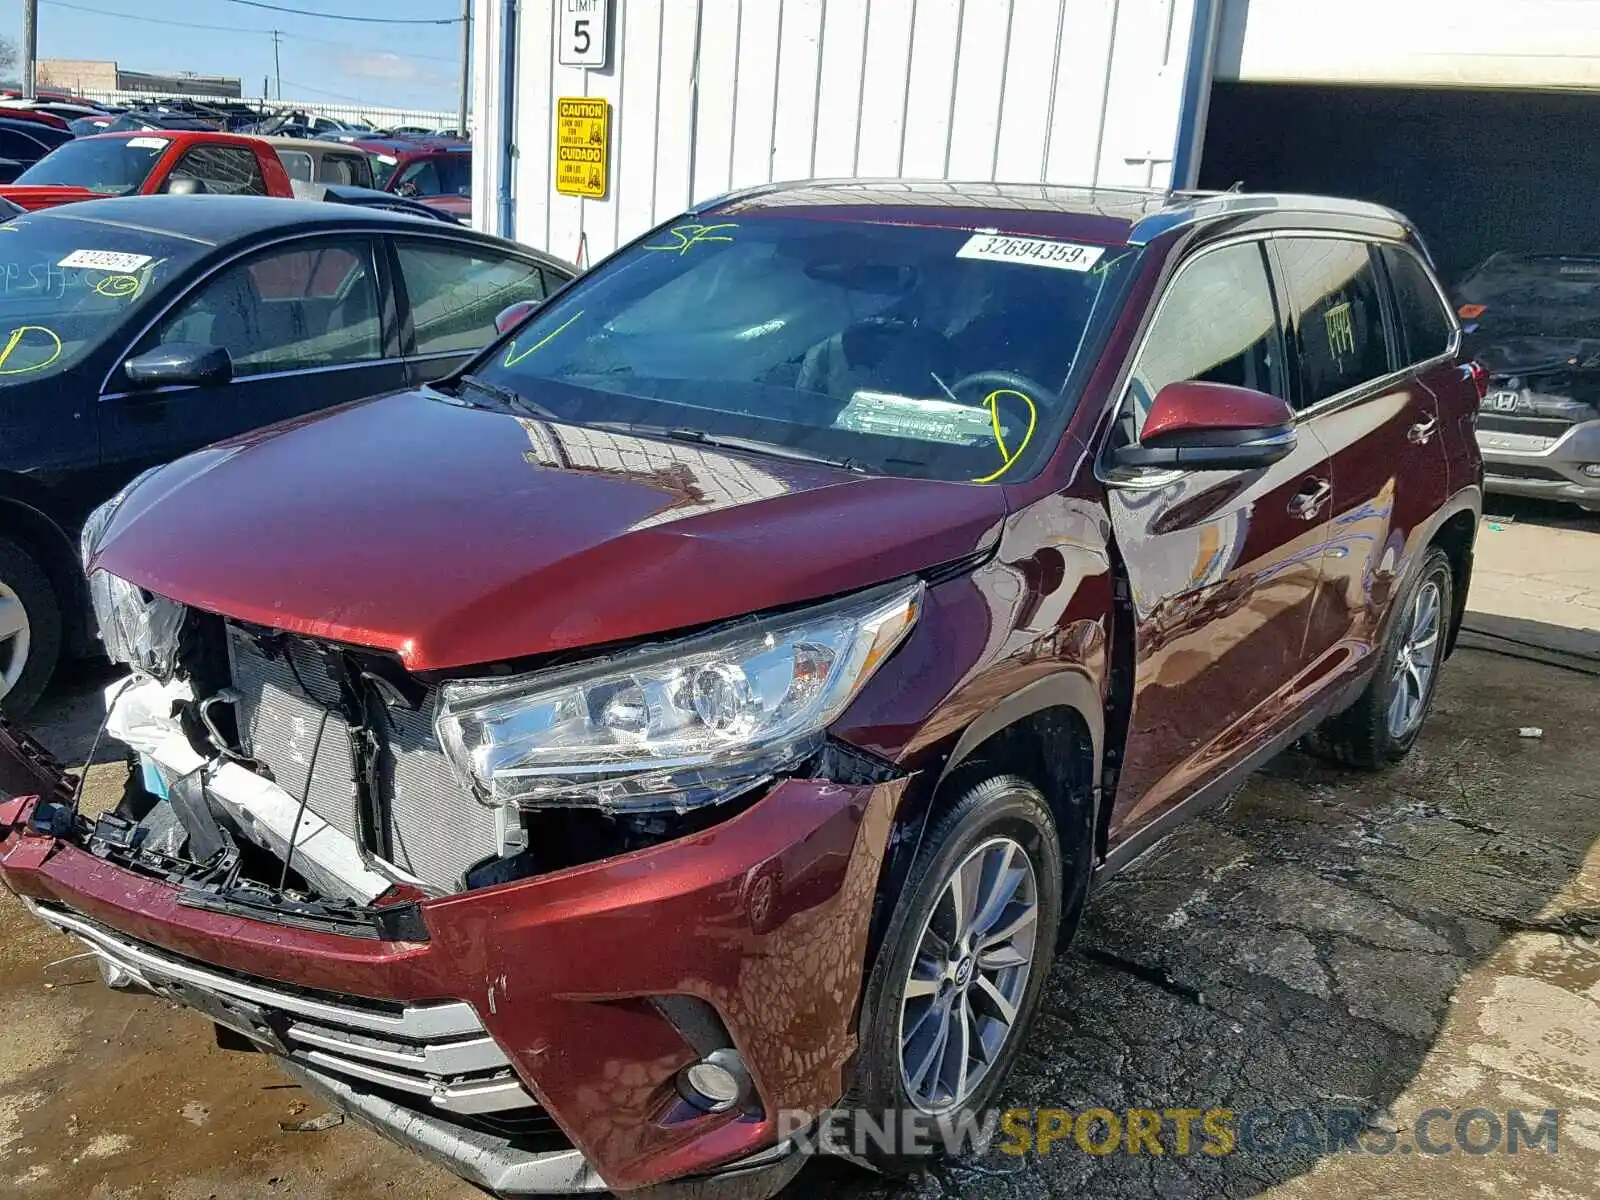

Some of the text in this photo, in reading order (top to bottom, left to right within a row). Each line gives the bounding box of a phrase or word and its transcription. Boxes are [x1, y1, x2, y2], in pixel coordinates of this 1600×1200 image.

[568, 0, 598, 12] LIMIT
[574, 20, 590, 54] 5
[562, 104, 601, 117] CAUTION
[561, 147, 600, 162] CUIDADO
[978, 237, 1084, 263] 32694359
